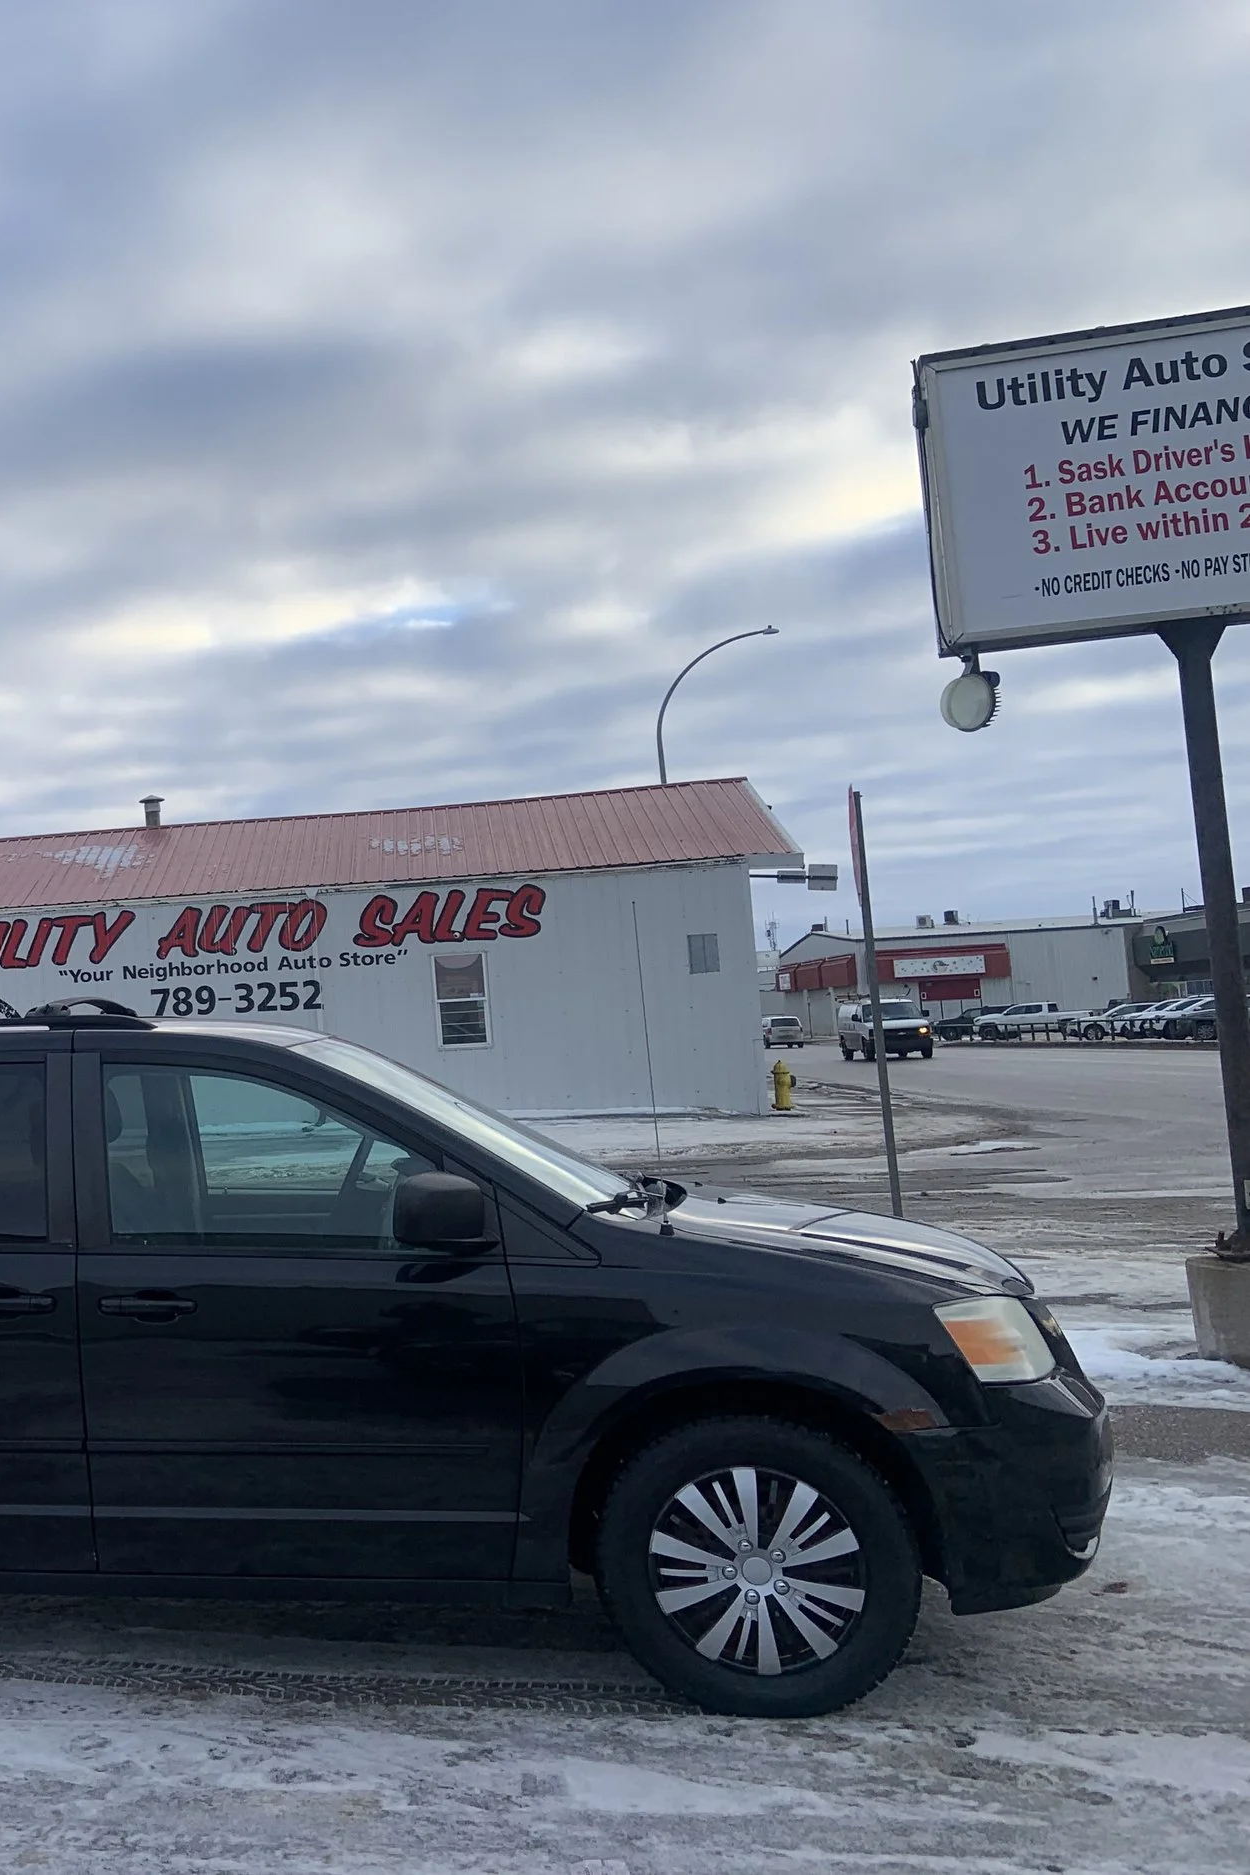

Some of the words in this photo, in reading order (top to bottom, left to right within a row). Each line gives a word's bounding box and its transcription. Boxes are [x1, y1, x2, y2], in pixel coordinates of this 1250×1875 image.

[976, 368, 1107, 410] Utility
[1122, 350, 1228, 390] Auto
[1061, 413, 1119, 445] WE
[1024, 464, 1051, 490] 1.
[1058, 453, 1125, 485] Sask
[1132, 438, 1236, 475] Driver's
[1027, 496, 1056, 522] 2.
[1065, 484, 1145, 518] Bank
[1154, 475, 1250, 506] Accou
[1032, 529, 1061, 555] 3.
[1069, 522, 1128, 550] Live
[1136, 507, 1230, 541] within
[1034, 576, 1061, 597] -NO
[1064, 569, 1113, 594] CREDIT
[1116, 562, 1170, 588] CHECKS
[1175, 559, 1200, 580] -NO
[1204, 555, 1229, 576] PAY
[1232, 552, 1250, 574] ST
[156, 897, 328, 960] AUTO
[352, 883, 547, 949] SALES
[122, 956, 269, 982] Neighborhood
[277, 952, 332, 972] Auto
[150, 979, 323, 1018] 789-3252
